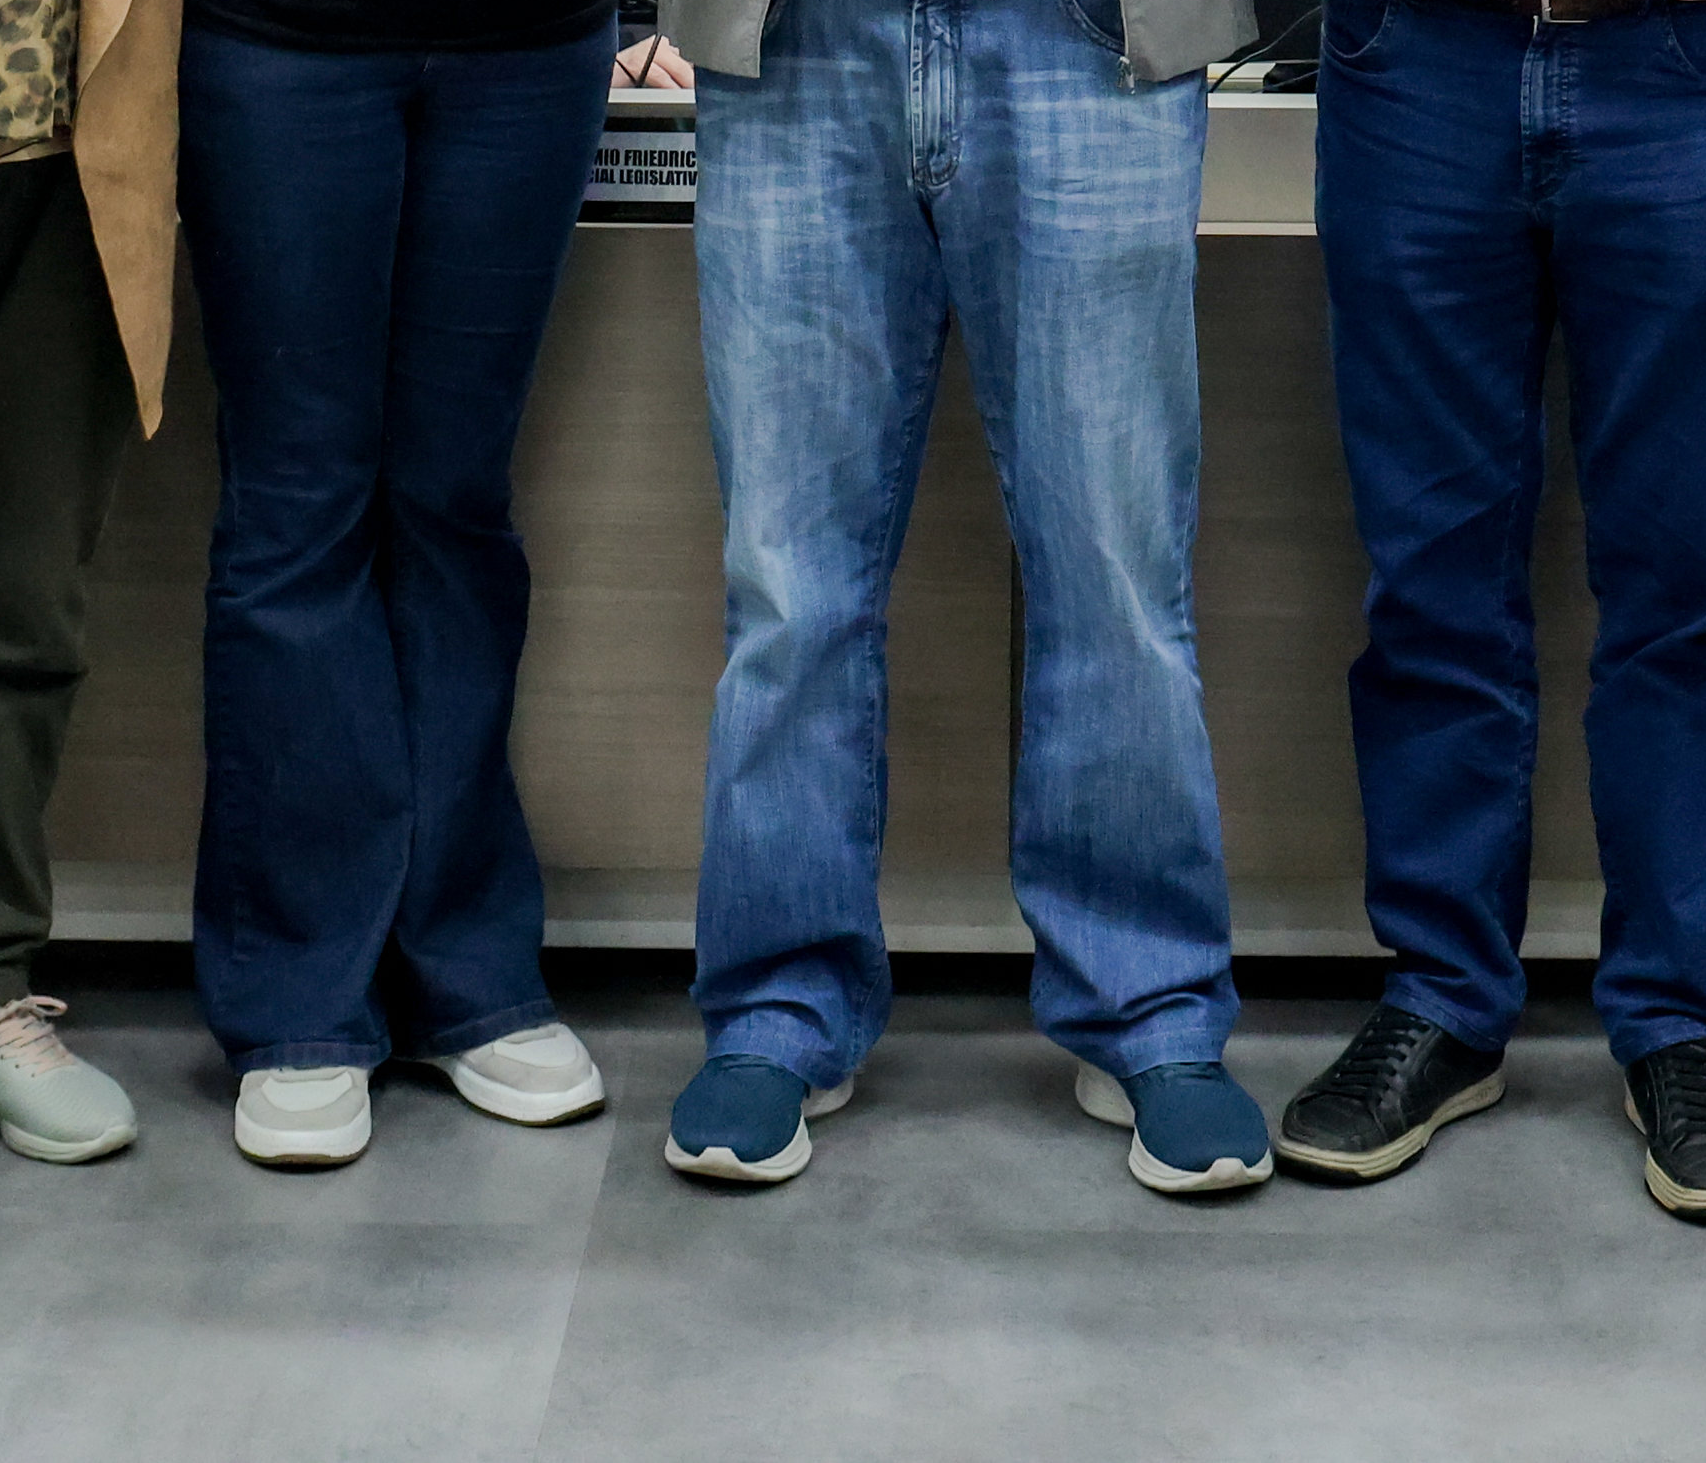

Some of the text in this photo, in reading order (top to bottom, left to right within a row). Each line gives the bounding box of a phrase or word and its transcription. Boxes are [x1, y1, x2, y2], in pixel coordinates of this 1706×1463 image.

[624, 149, 697, 168] FRIEDRIC
[589, 168, 698, 186] IAL LEGISLATIV
